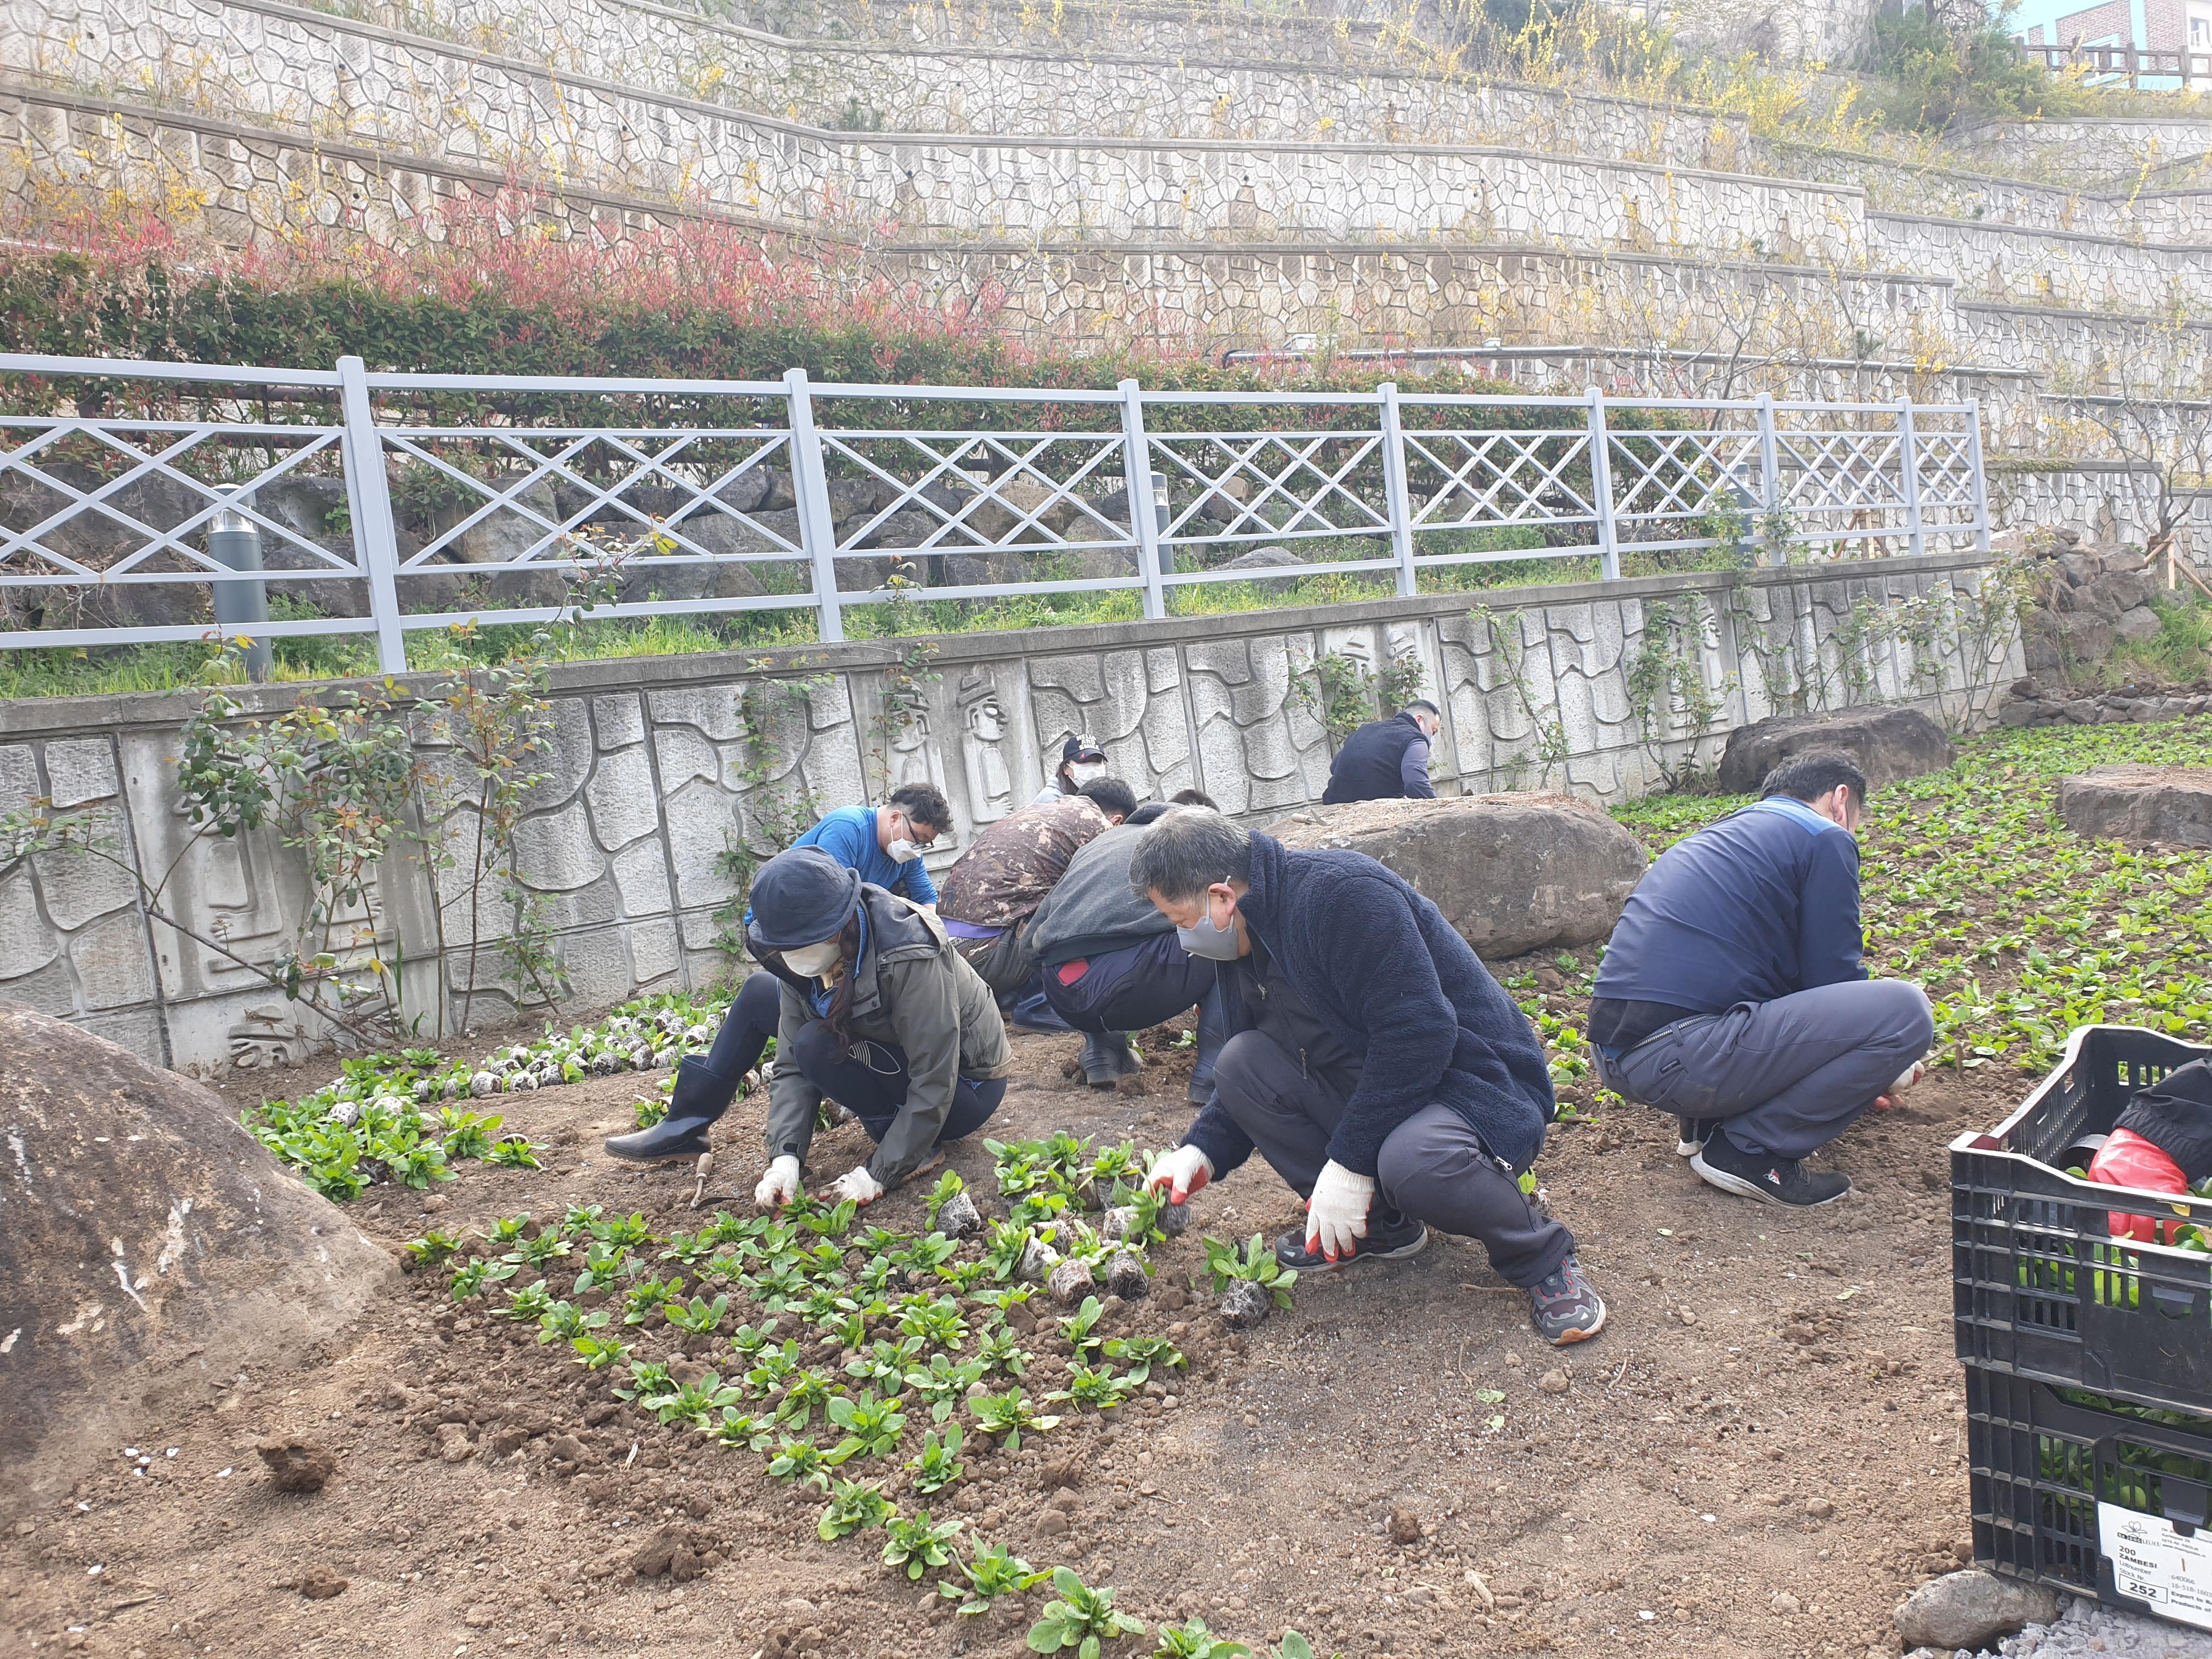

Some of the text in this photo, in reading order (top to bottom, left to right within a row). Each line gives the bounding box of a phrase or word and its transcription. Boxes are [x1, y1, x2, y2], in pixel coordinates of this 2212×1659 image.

[2119, 1545, 2136, 1556] 200
[2119, 1553, 2157, 1568] ZAMBESI
[2119, 1567, 2135, 1578] Stock
[2130, 1582, 2157, 1598] 252
[2171, 1591, 2194, 1600] Export
[2171, 1599, 2202, 1611] Products
